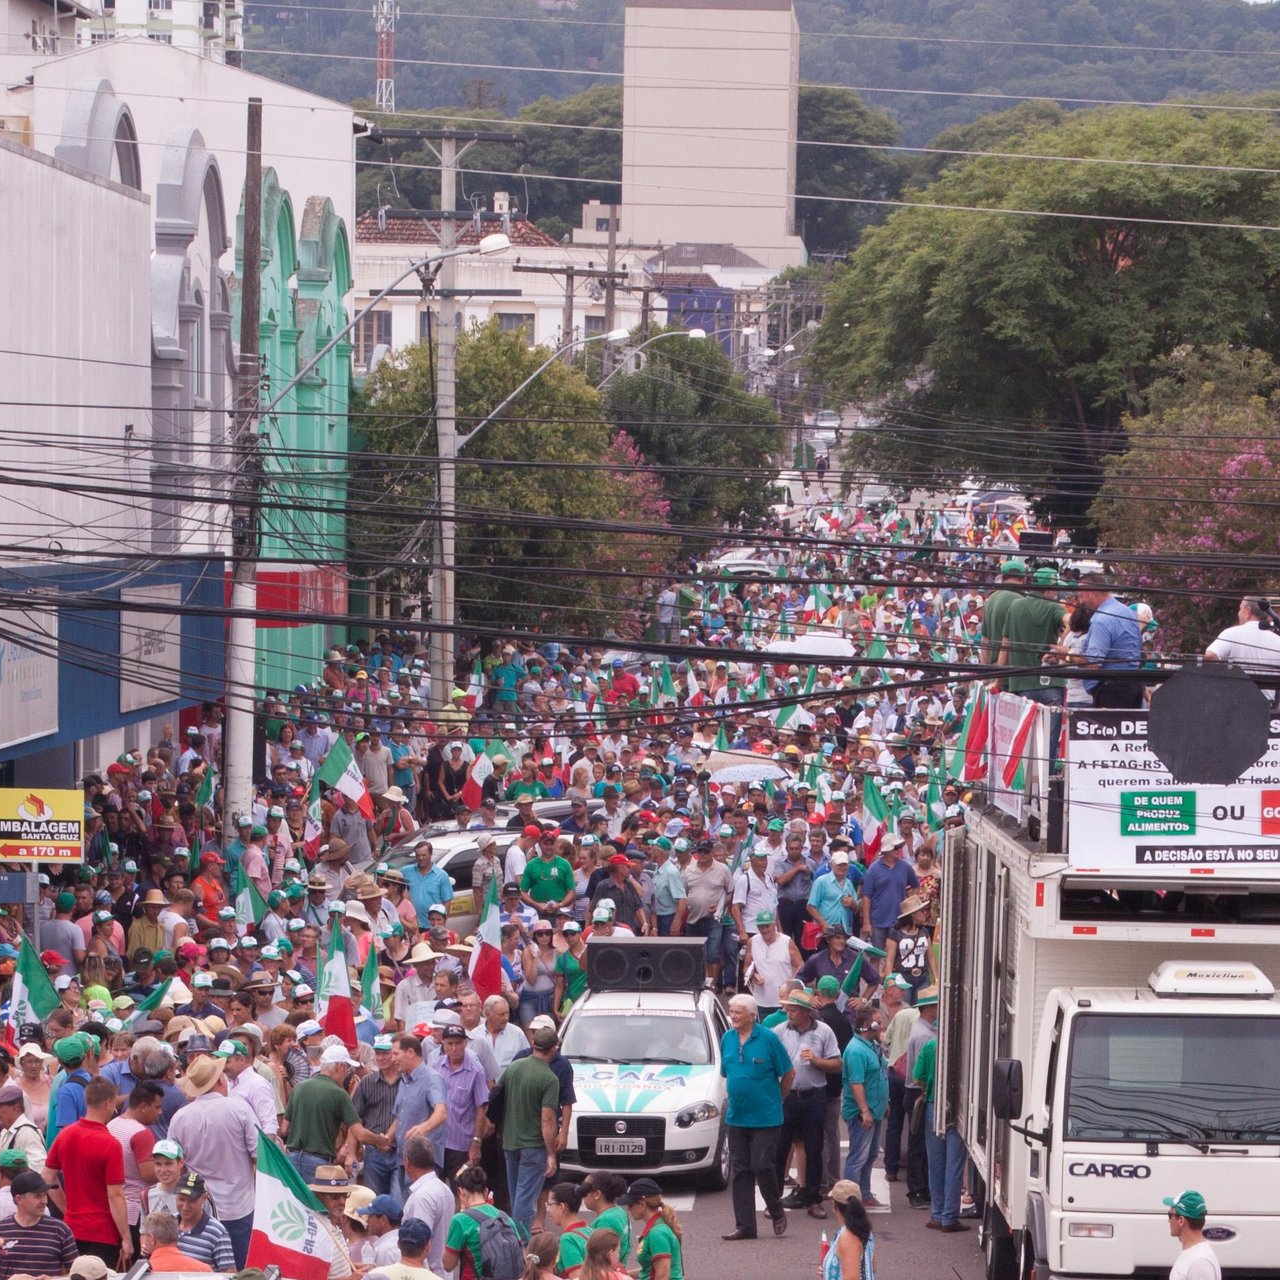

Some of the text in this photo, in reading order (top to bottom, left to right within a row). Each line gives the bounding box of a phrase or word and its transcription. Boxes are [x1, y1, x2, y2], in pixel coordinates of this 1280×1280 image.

[1110, 743, 1120, 752] A
[1098, 778, 1151, 789] querem
[1134, 796, 1183, 806] DE QUEM
[1212, 805, 1245, 821] OU
[1127, 822, 1190, 832] ALIMENTOS
[21, 833, 51, 841] SANTA
[18, 847, 71, 857] a 170 m
[1144, 851, 1153, 861] A
[1155, 848, 1203, 861] DECISÃO
[1206, 848, 1235, 860] ESTÁ
[1238, 850, 1254, 860] NO
[1256, 850, 1278, 861] SEU
[1068, 1162, 1151, 1179] CARGO
